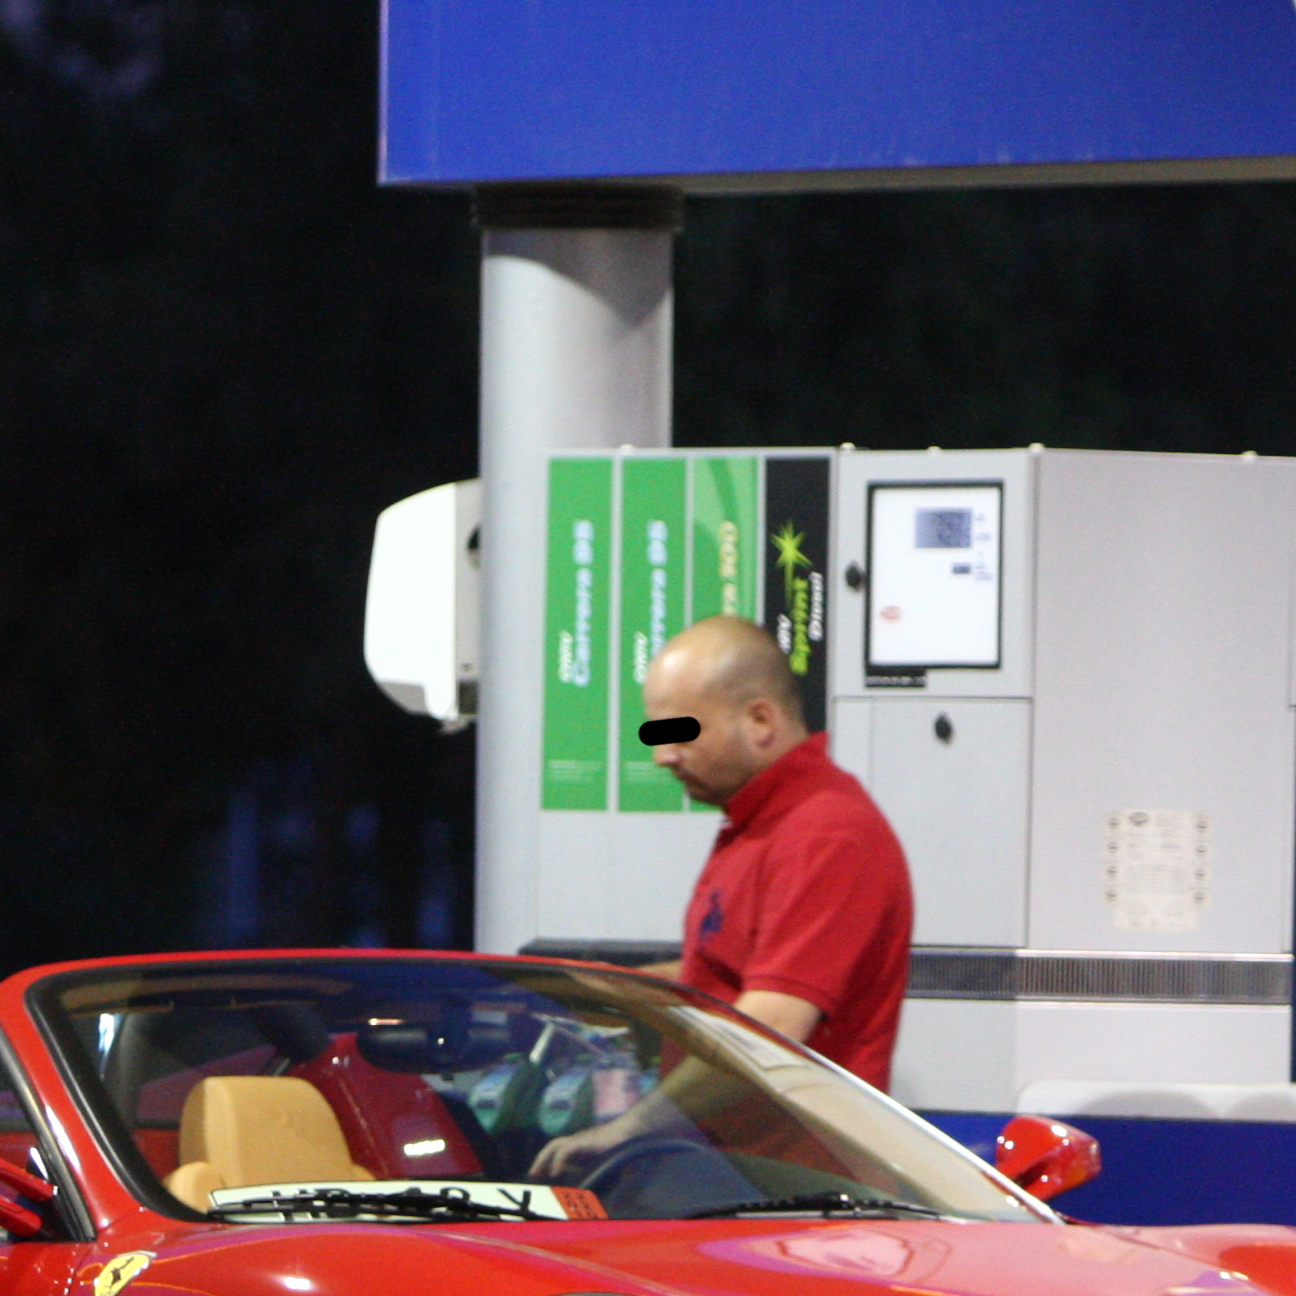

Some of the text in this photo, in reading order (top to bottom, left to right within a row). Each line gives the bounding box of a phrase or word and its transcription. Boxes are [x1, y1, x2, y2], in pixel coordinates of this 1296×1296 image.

[573, 568, 591, 687] Carrera
[789, 577, 811, 676] Sprint
[808, 571, 823, 641] Diesel
